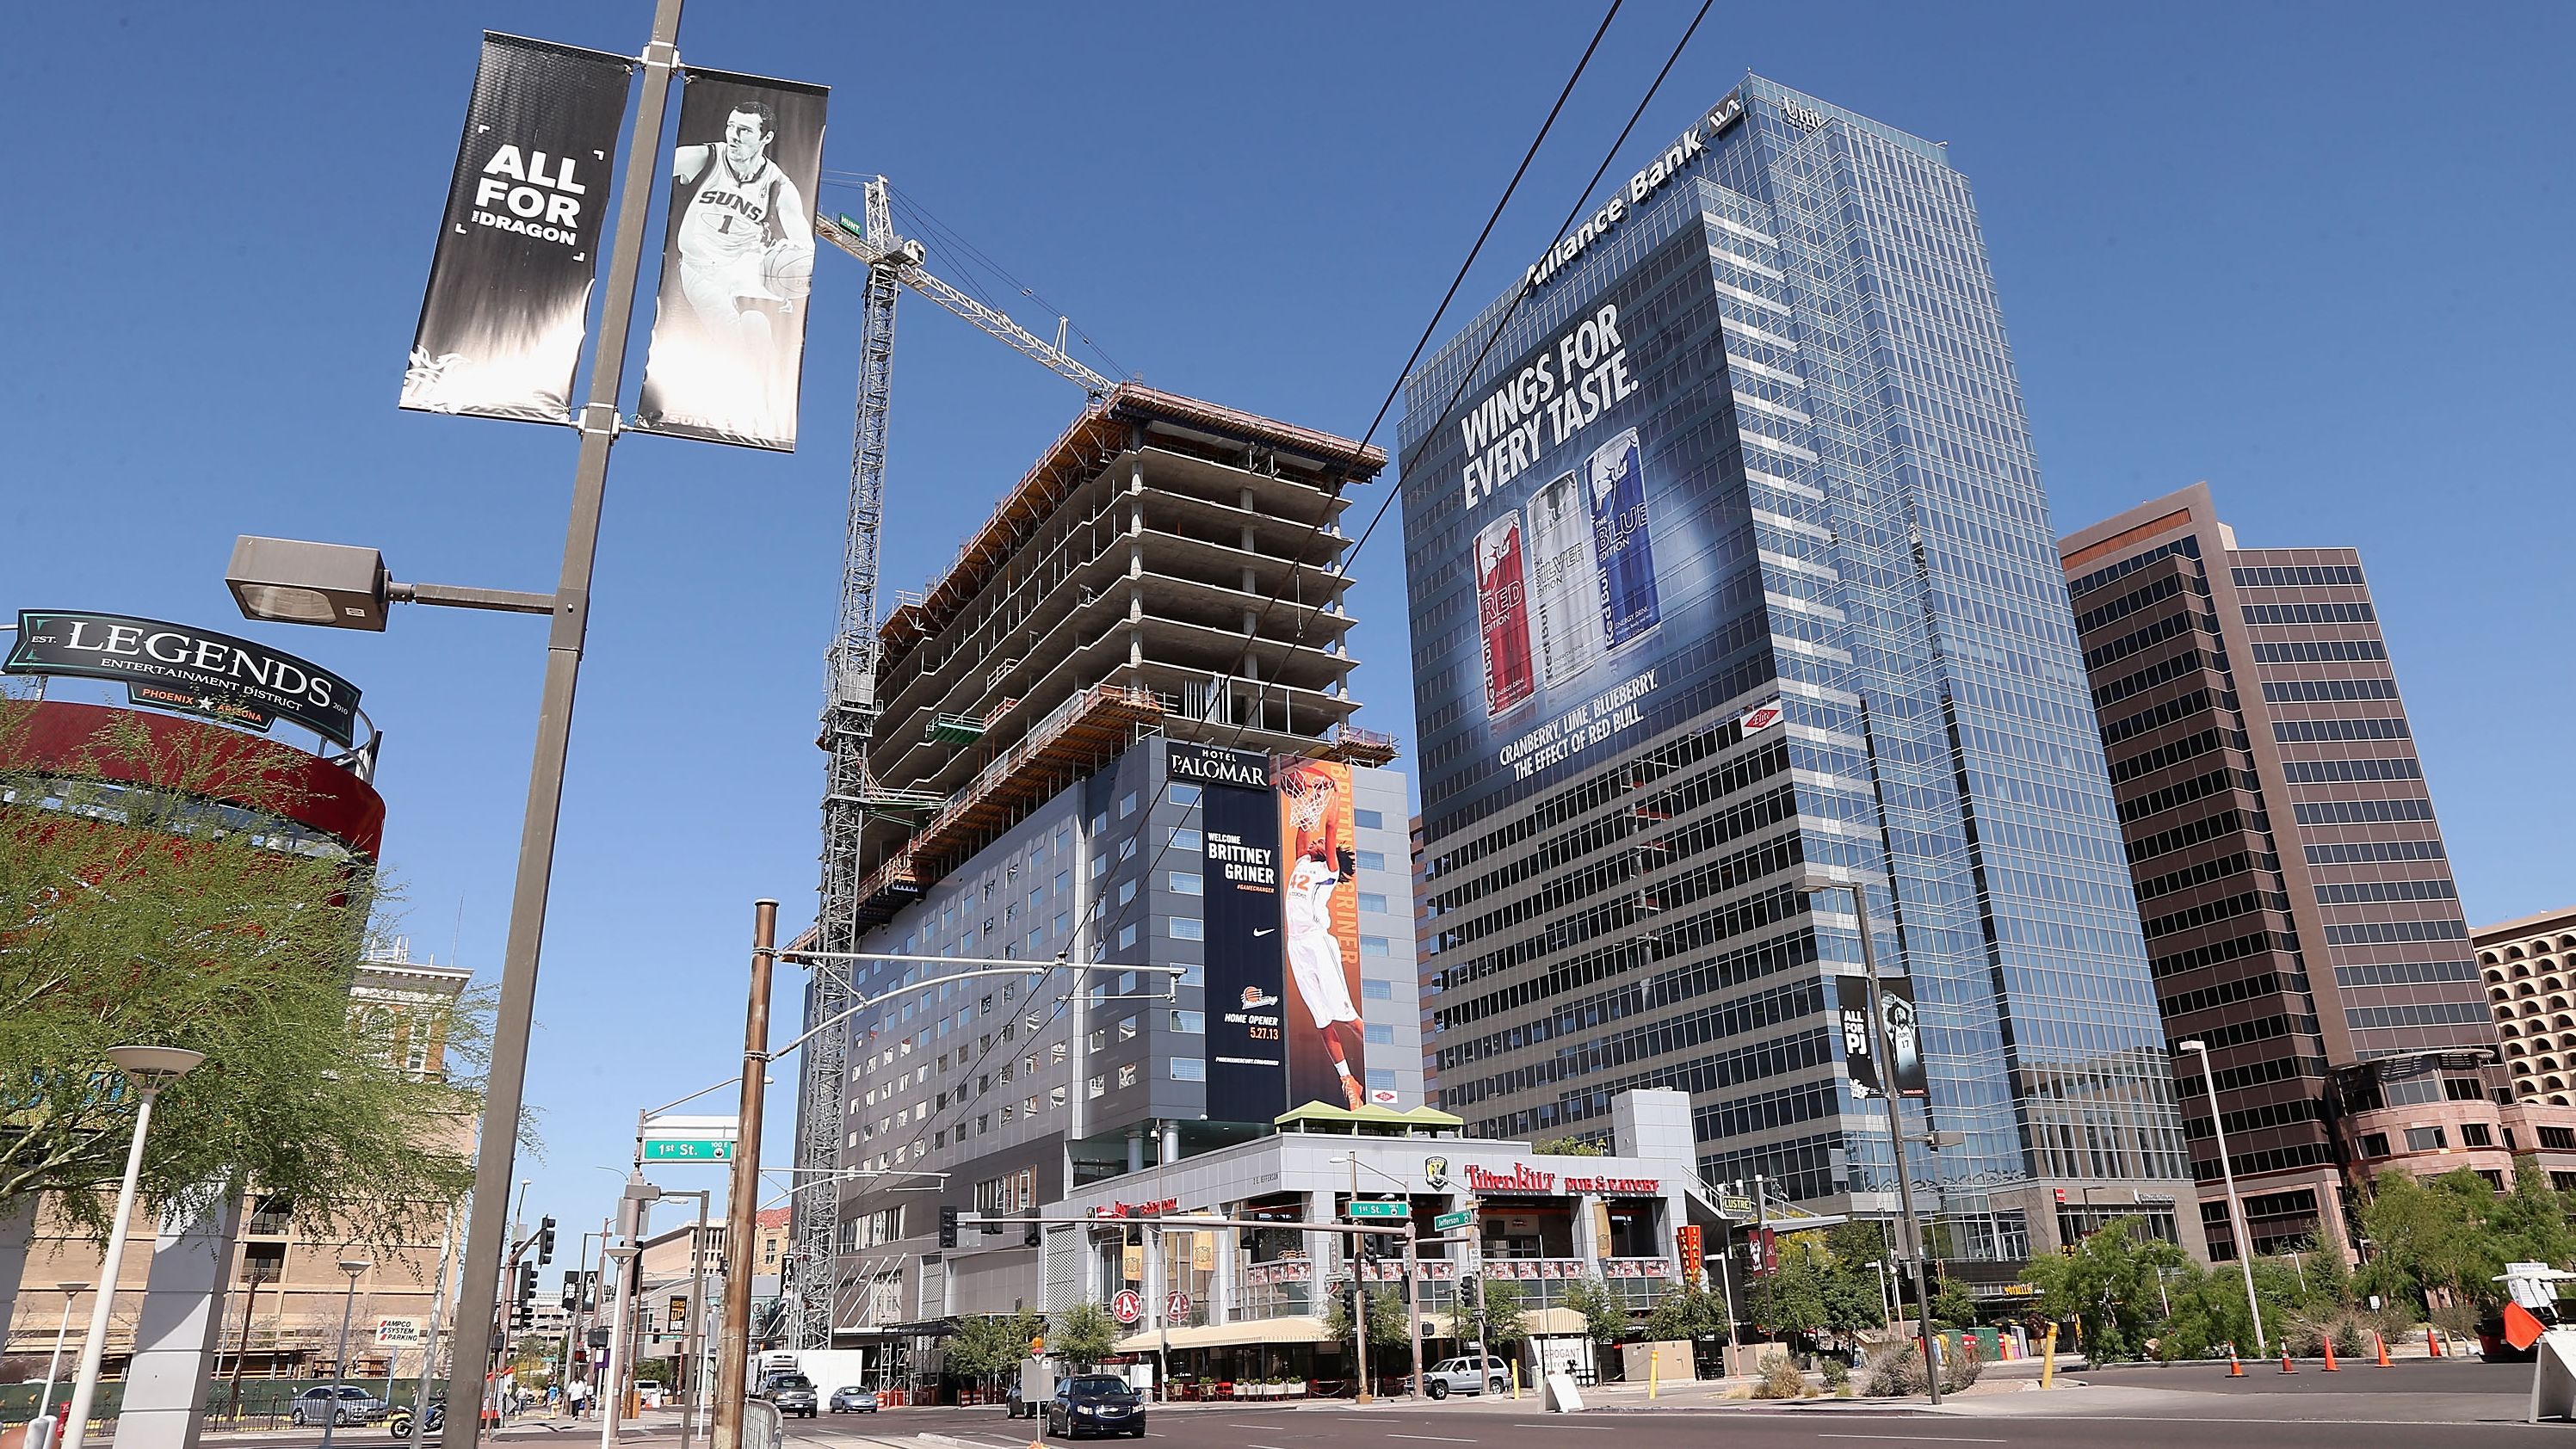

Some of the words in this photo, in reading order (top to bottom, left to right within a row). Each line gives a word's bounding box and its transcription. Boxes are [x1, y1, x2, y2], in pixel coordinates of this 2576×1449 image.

[482, 144, 586, 195] ALL
[474, 176, 578, 229] FOR
[699, 190, 763, 221] SUNS
[1523, 197, 1624, 297] Alliance
[1630, 128, 1703, 203] Bank
[471, 210, 480, 223] THE
[479, 211, 577, 246] DRAGON
[718, 215, 733, 235] 1
[841, 214, 860, 232] HUNT
[1461, 353, 1554, 458] WINGS
[1560, 304, 1622, 385] FOR
[1463, 410, 1541, 511] EVERY
[1547, 348, 1639, 447] TASTE.
[1595, 515, 1608, 529] THE
[1597, 502, 1647, 552] BLUE
[1599, 536, 1630, 563] EDITION
[1534, 557, 1543, 569] THE
[1535, 542, 1585, 589] SILVER
[1481, 590, 1492, 601] THE
[1598, 565, 1609, 605] Bull
[1481, 580, 1523, 625] RED
[1484, 613, 1510, 635] EDITION
[1602, 605, 1615, 647] Red
[31, 635, 57, 644] EST.
[64, 620, 335, 708] LEGENDS
[1482, 637, 1492, 673] Bull
[101, 658, 240, 691] ENTERTAINMENT
[243, 686, 303, 712] DISTRICT
[1485, 673, 1495, 712] Red
[142, 688, 195, 705] PHOENIX
[332, 702, 349, 715] 2010
[1499, 719, 1561, 766] CRANBERRY,
[1563, 705, 1592, 735] LIME,
[1593, 669, 1658, 719] BLUEBERRY.
[1514, 756, 1534, 781] THE
[1535, 737, 1569, 771] EFFECT
[1571, 730, 1586, 753] OF
[1589, 718, 1611, 745] RED
[1612, 703, 1645, 733] BULL.
[1202, 749, 1237, 762] HOTEL
[1171, 754, 1267, 786] PALOMAR
[1208, 832, 1241, 844] WELCOME
[1208, 842, 1271, 866] BRITTNEY
[1225, 863, 1275, 885] GRINER
[1237, 884, 1275, 893] #GAMECHANGER
[1224, 1013, 1248, 1024] HOME
[1248, 1014, 1279, 1027] OPENER
[1844, 1010, 1863, 1022] ALL
[1250, 1027, 1279, 1040] 5.27.13
[1844, 1022, 1864, 1033] FOR
[1845, 1033, 1867, 1054] PJ
[658, 1144, 675, 1156] 1st
[679, 1144, 698, 1156] St.
[1358, 1205, 1368, 1214] 1st
[1370, 1205, 1382, 1214] St.
[1724, 1199, 1750, 1210] LUSTRE
[1437, 1217, 1460, 1228] Jefferson
[671, 1308, 685, 1321] UP
[1121, 1296, 1135, 1316] A
